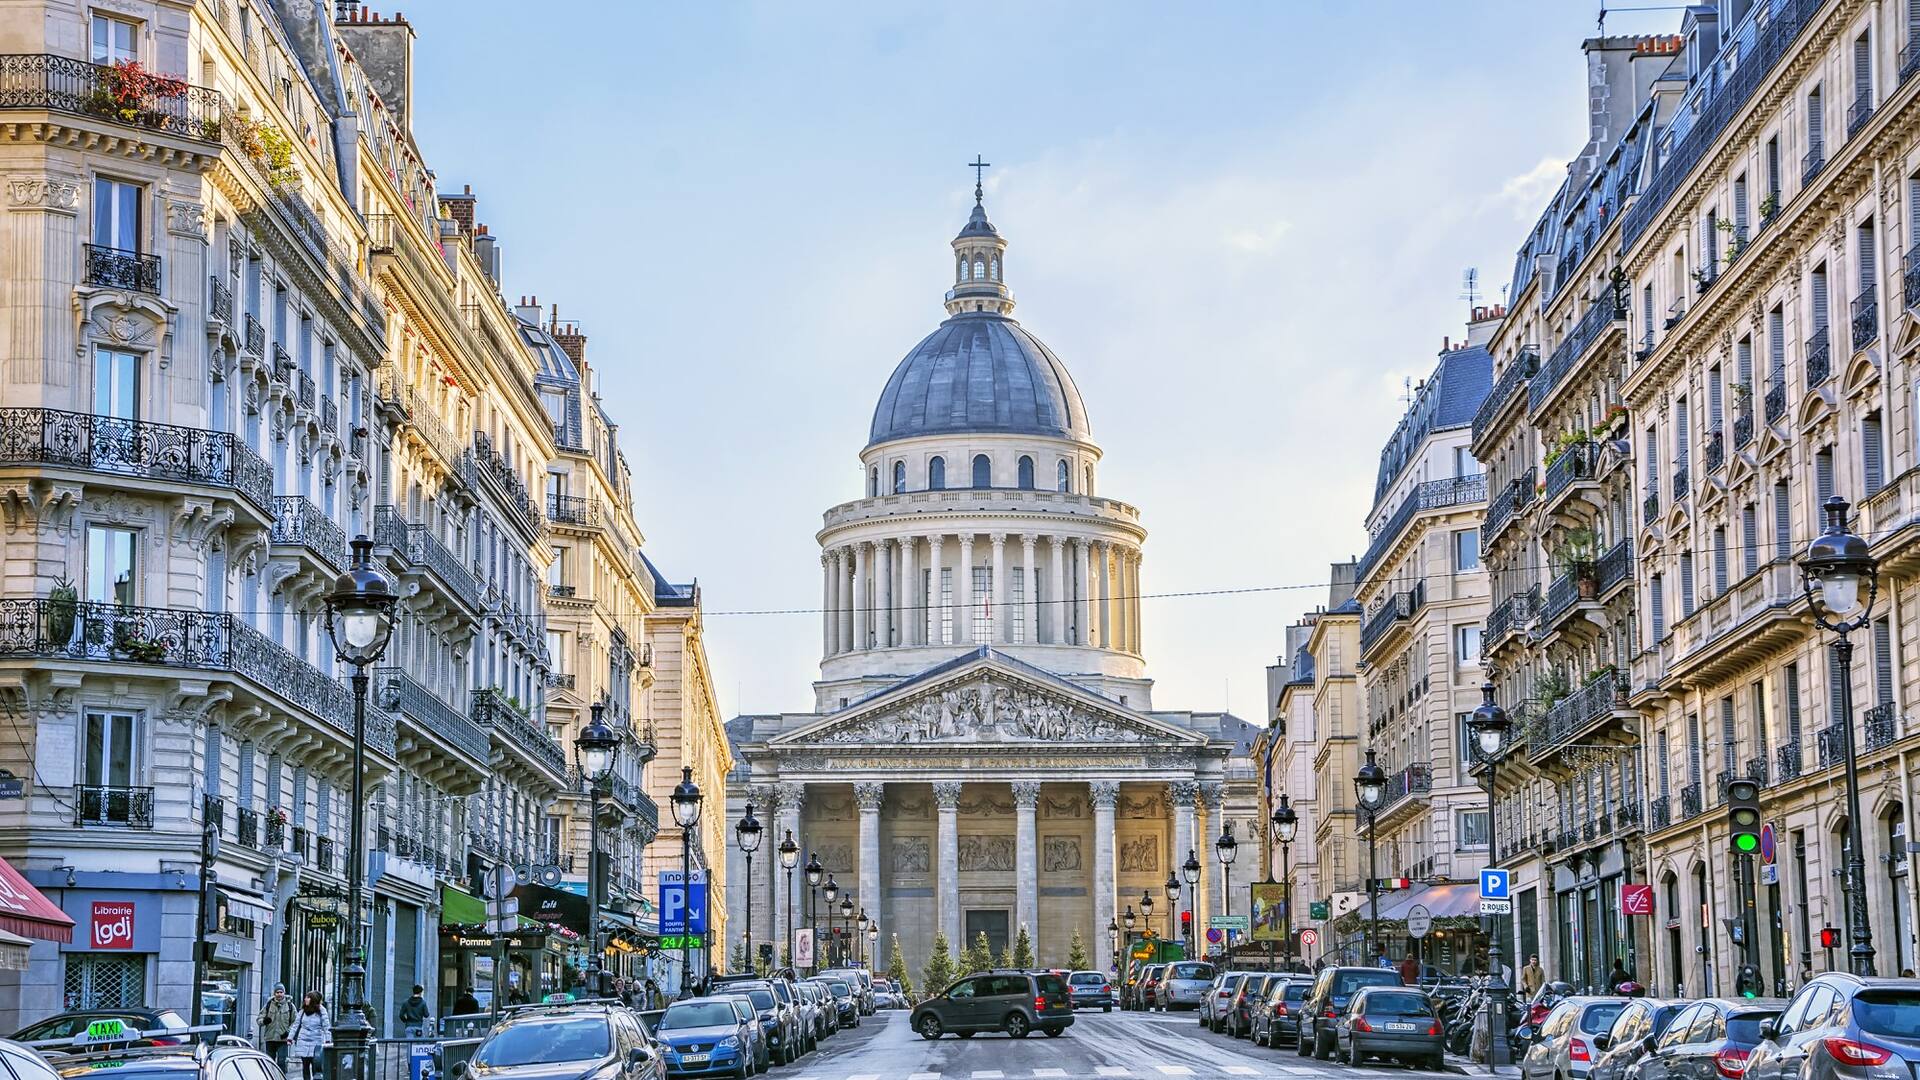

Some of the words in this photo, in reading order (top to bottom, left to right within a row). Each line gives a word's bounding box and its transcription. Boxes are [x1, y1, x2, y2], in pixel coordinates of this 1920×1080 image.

[1488, 875, 1501, 893] P
[95, 906, 132, 915] Librairie
[665, 889, 686, 920] P
[95, 917, 131, 944] lgdj
[460, 938, 491, 946] Pomme
[94, 1021, 121, 1035] TAXI
